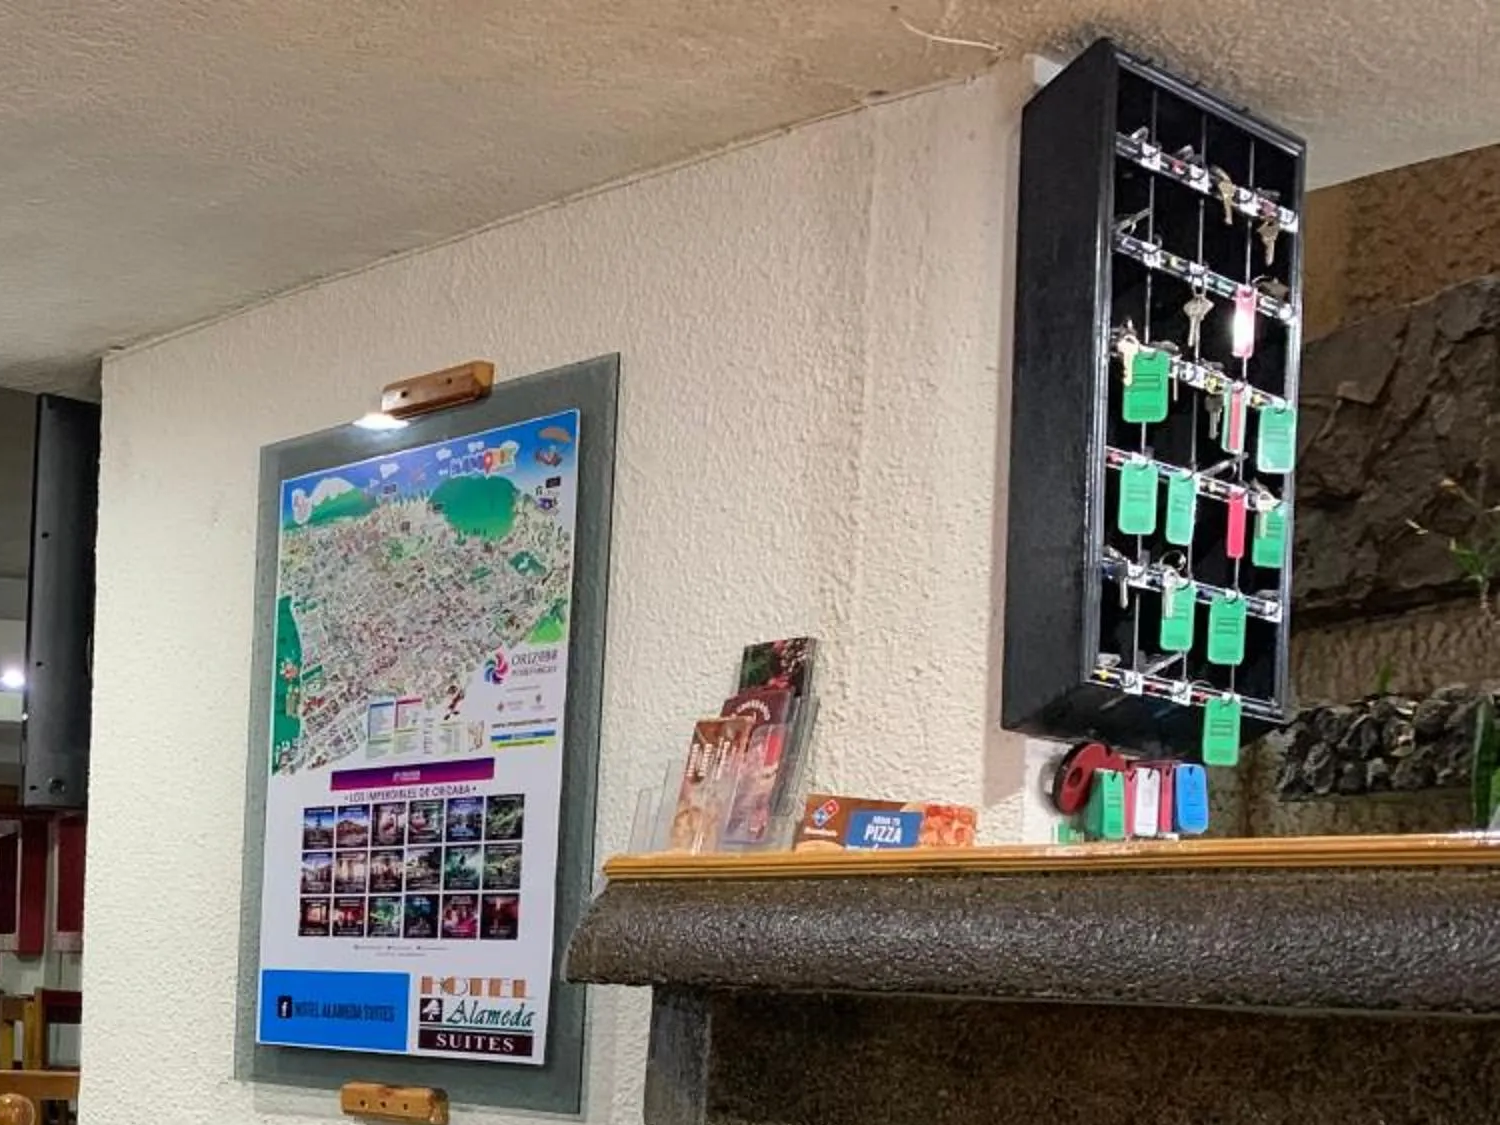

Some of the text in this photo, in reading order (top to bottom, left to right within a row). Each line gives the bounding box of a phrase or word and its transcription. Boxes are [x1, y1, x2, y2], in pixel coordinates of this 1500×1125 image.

[863, 824, 903, 844] PIZZA
[421, 975, 533, 1000] HOTEL
[445, 999, 535, 1027] Alameda
[436, 1033, 515, 1053] SUITES
